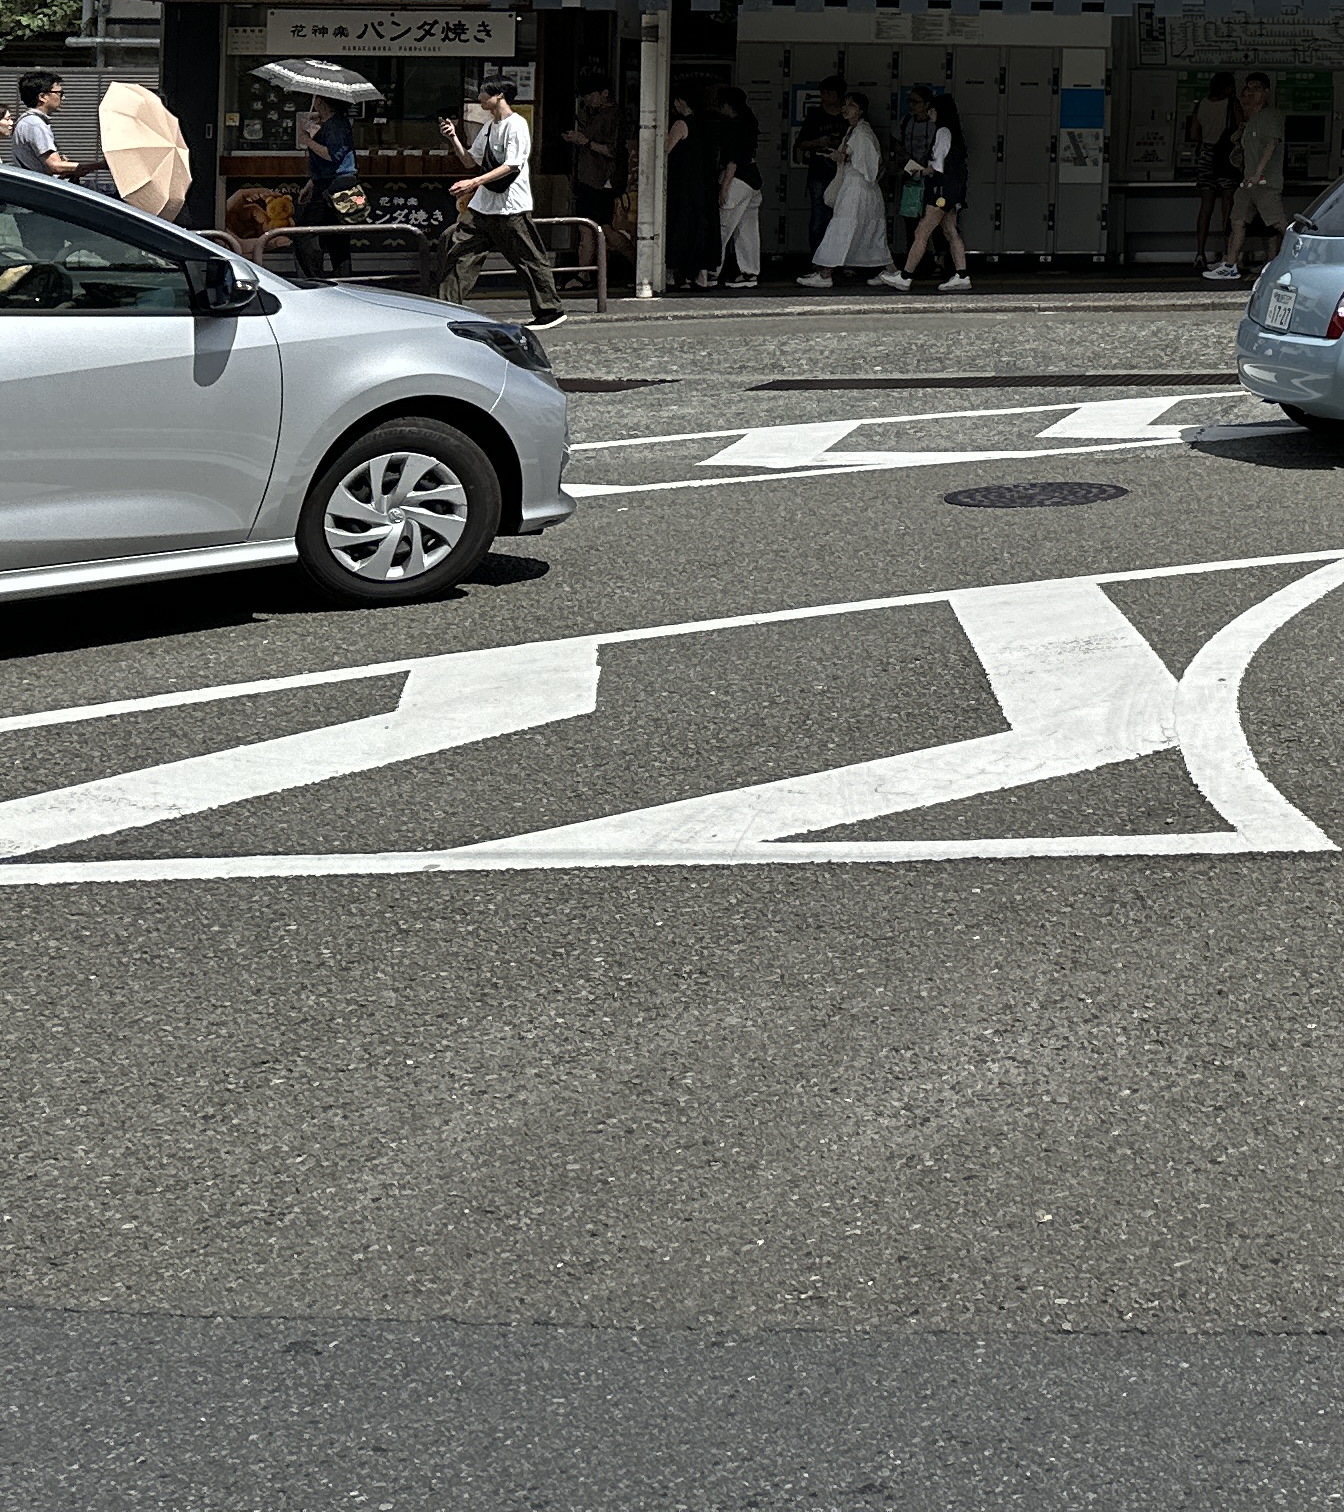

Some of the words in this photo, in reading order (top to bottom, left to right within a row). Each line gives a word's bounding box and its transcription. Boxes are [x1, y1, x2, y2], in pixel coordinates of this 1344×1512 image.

[356, 20, 493, 43] パンダ焼き
